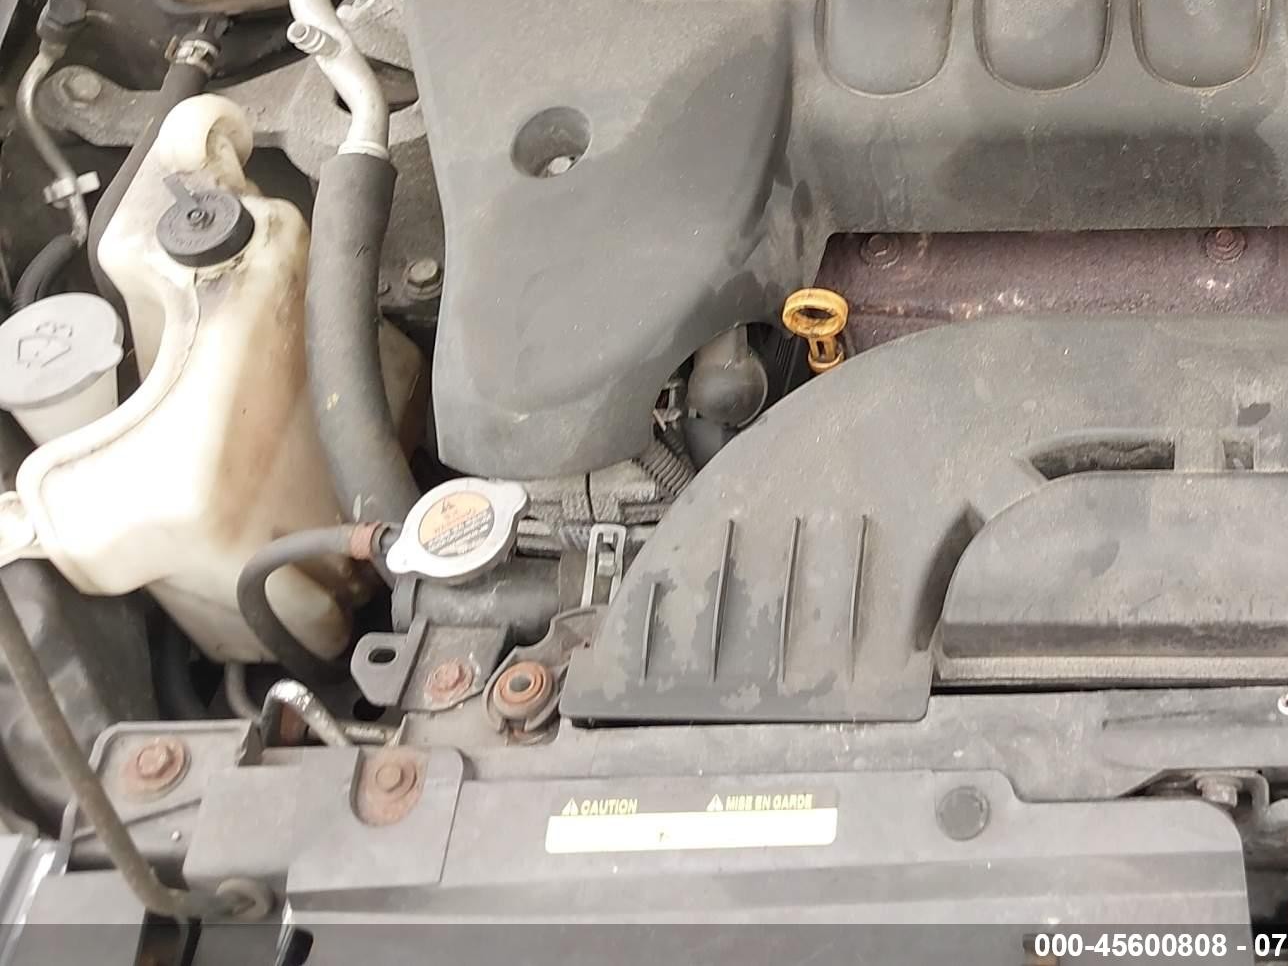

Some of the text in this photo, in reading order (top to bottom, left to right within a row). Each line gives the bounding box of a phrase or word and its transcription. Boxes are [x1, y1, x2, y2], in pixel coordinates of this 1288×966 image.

[580, 799, 638, 815] CAUTION
[726, 794, 813, 810] MISE EN GARDE
